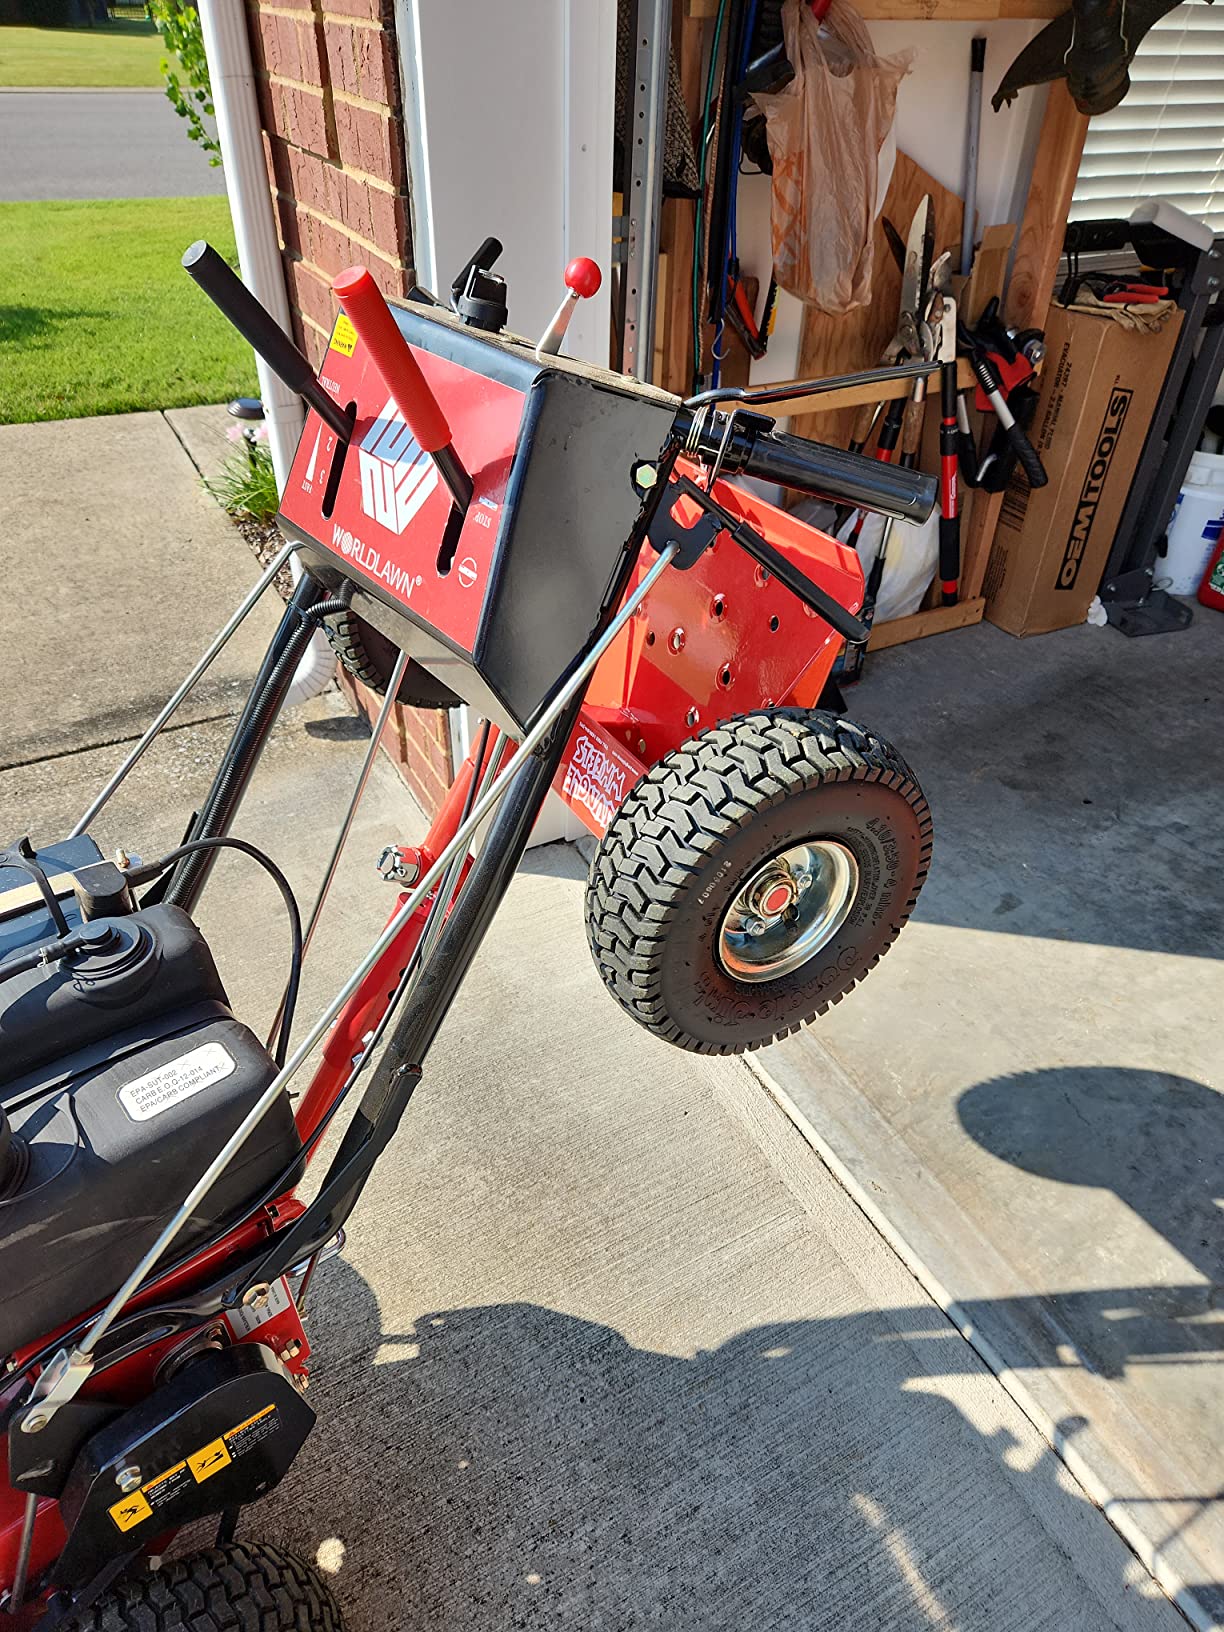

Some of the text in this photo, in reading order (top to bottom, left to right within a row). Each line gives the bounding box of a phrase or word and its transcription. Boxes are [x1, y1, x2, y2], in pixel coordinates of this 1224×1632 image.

[1053, 341, 1071, 389] EVACUATOR
[1039, 410, 1052, 440] GALLON
[326, 436, 333, 452] 2
[319, 469, 326, 485] 3
[474, 511, 492, 529] STOP
[129, 1069, 179, 1098] EPA-SUT-002
[139, 1065, 221, 1113] EPA/CARB COMPLIANT
[135, 1090, 158, 1105] CARB
